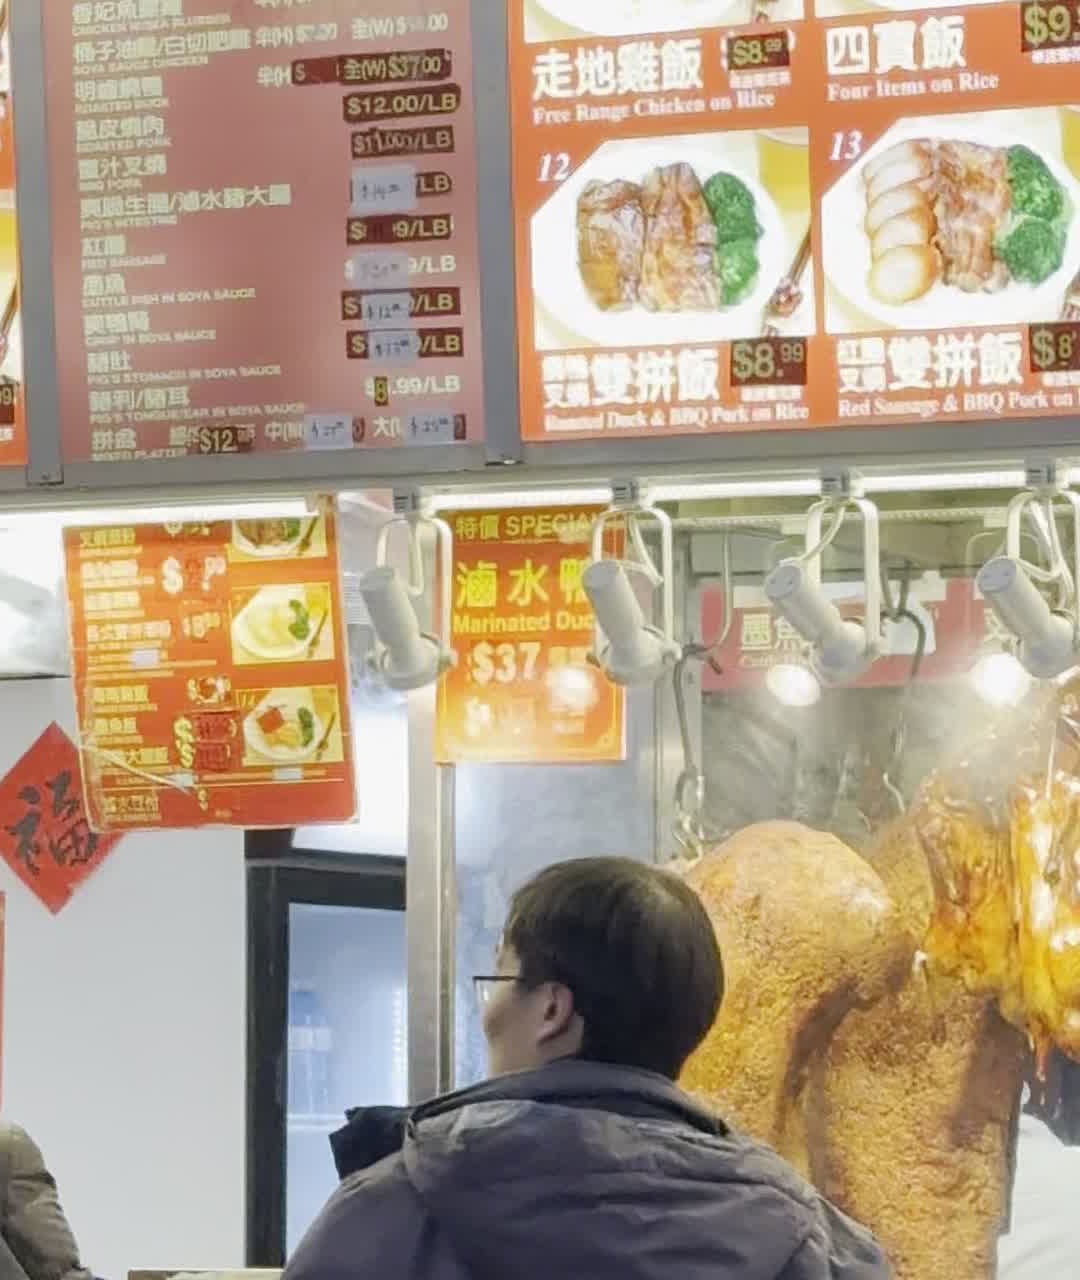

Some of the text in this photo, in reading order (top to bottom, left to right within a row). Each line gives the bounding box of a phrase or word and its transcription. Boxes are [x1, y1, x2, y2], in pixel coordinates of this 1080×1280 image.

[826, 15, 967, 75] 四寶飯
[533, 39, 703, 100] 走地雞飯
[826, 72, 1000, 101] Four Items on Rice
[347, 93, 457, 115] $12.00/LB
[533, 89, 776, 126] Free Range Chicken on Rice
[830, 130, 862, 161] 13
[538, 152, 570, 182] 12
[733, 342, 804, 379] $8.99
[775, 401, 809, 419] Rice
[838, 398, 870, 418] Red
[943, 394, 958, 412] &
[964, 391, 1004, 414] BBQ
[1009, 389, 1049, 410] Pork
[1052, 392, 1073, 408] on
[456, 512, 597, 540] 特價 SPECIA
[453, 611, 597, 634] Marinated Duc
[471, 640, 541, 686] $37
